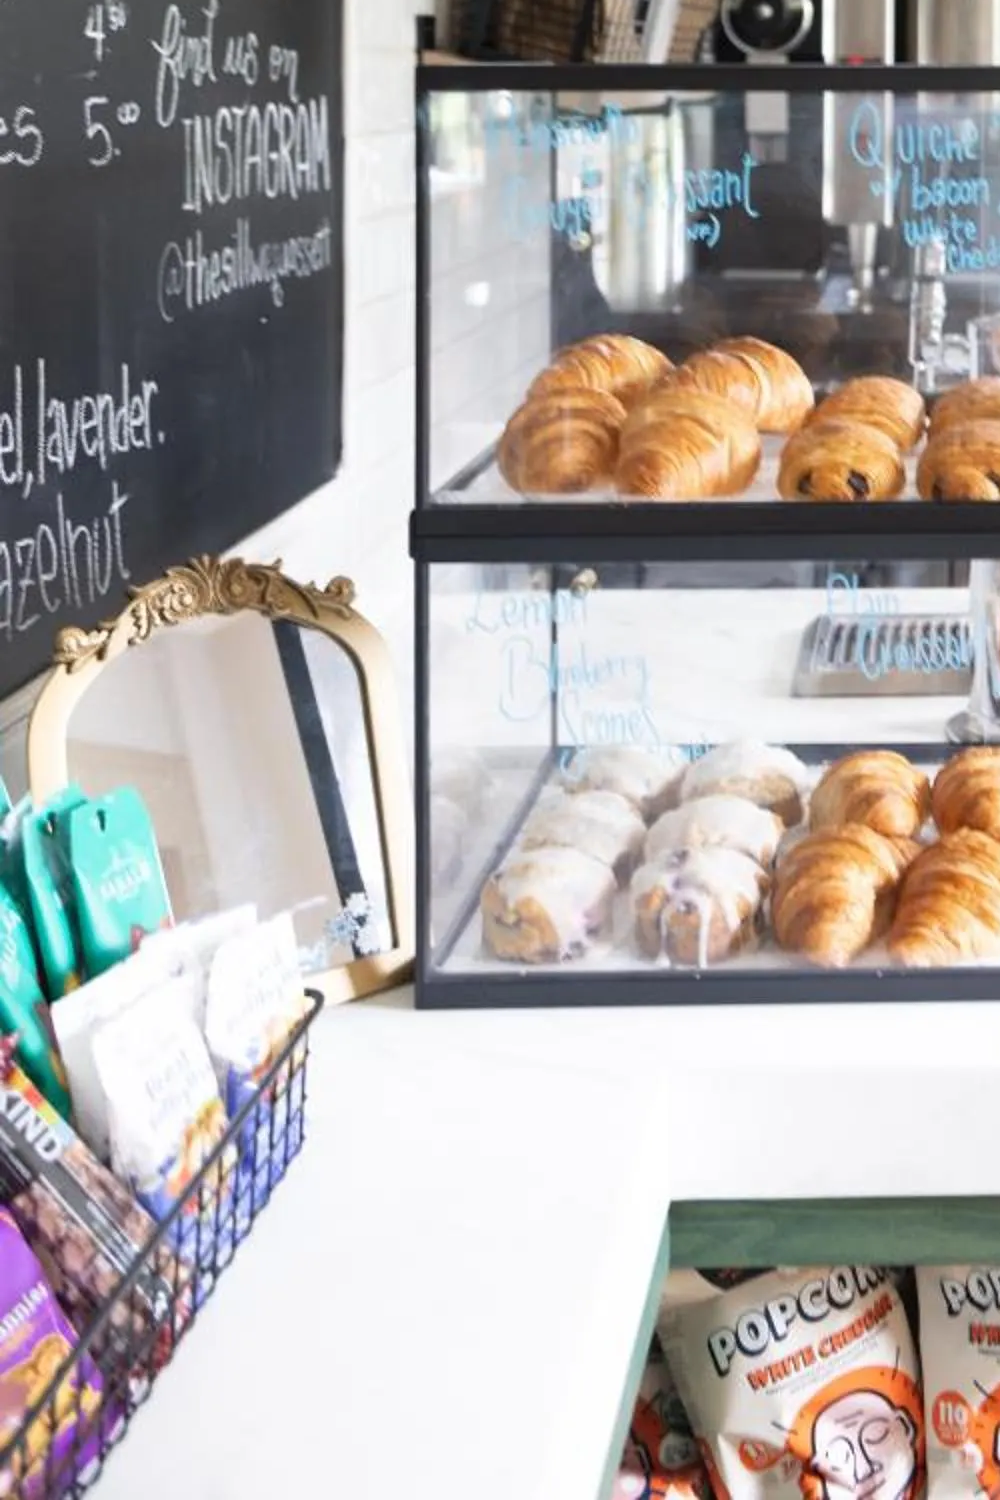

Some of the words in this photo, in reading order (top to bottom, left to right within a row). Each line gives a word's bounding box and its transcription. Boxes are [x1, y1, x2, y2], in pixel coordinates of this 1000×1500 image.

[224, 32, 260, 86] us
[268, 43, 300, 103] on
[181, 95, 333, 214] INSTAGRAM
[912, 162, 990, 211] bacon
[464, 578, 589, 635] Lemon
[746, 1346, 817, 1392] WHITE
[817, 1292, 894, 1360] CHEDDAR
